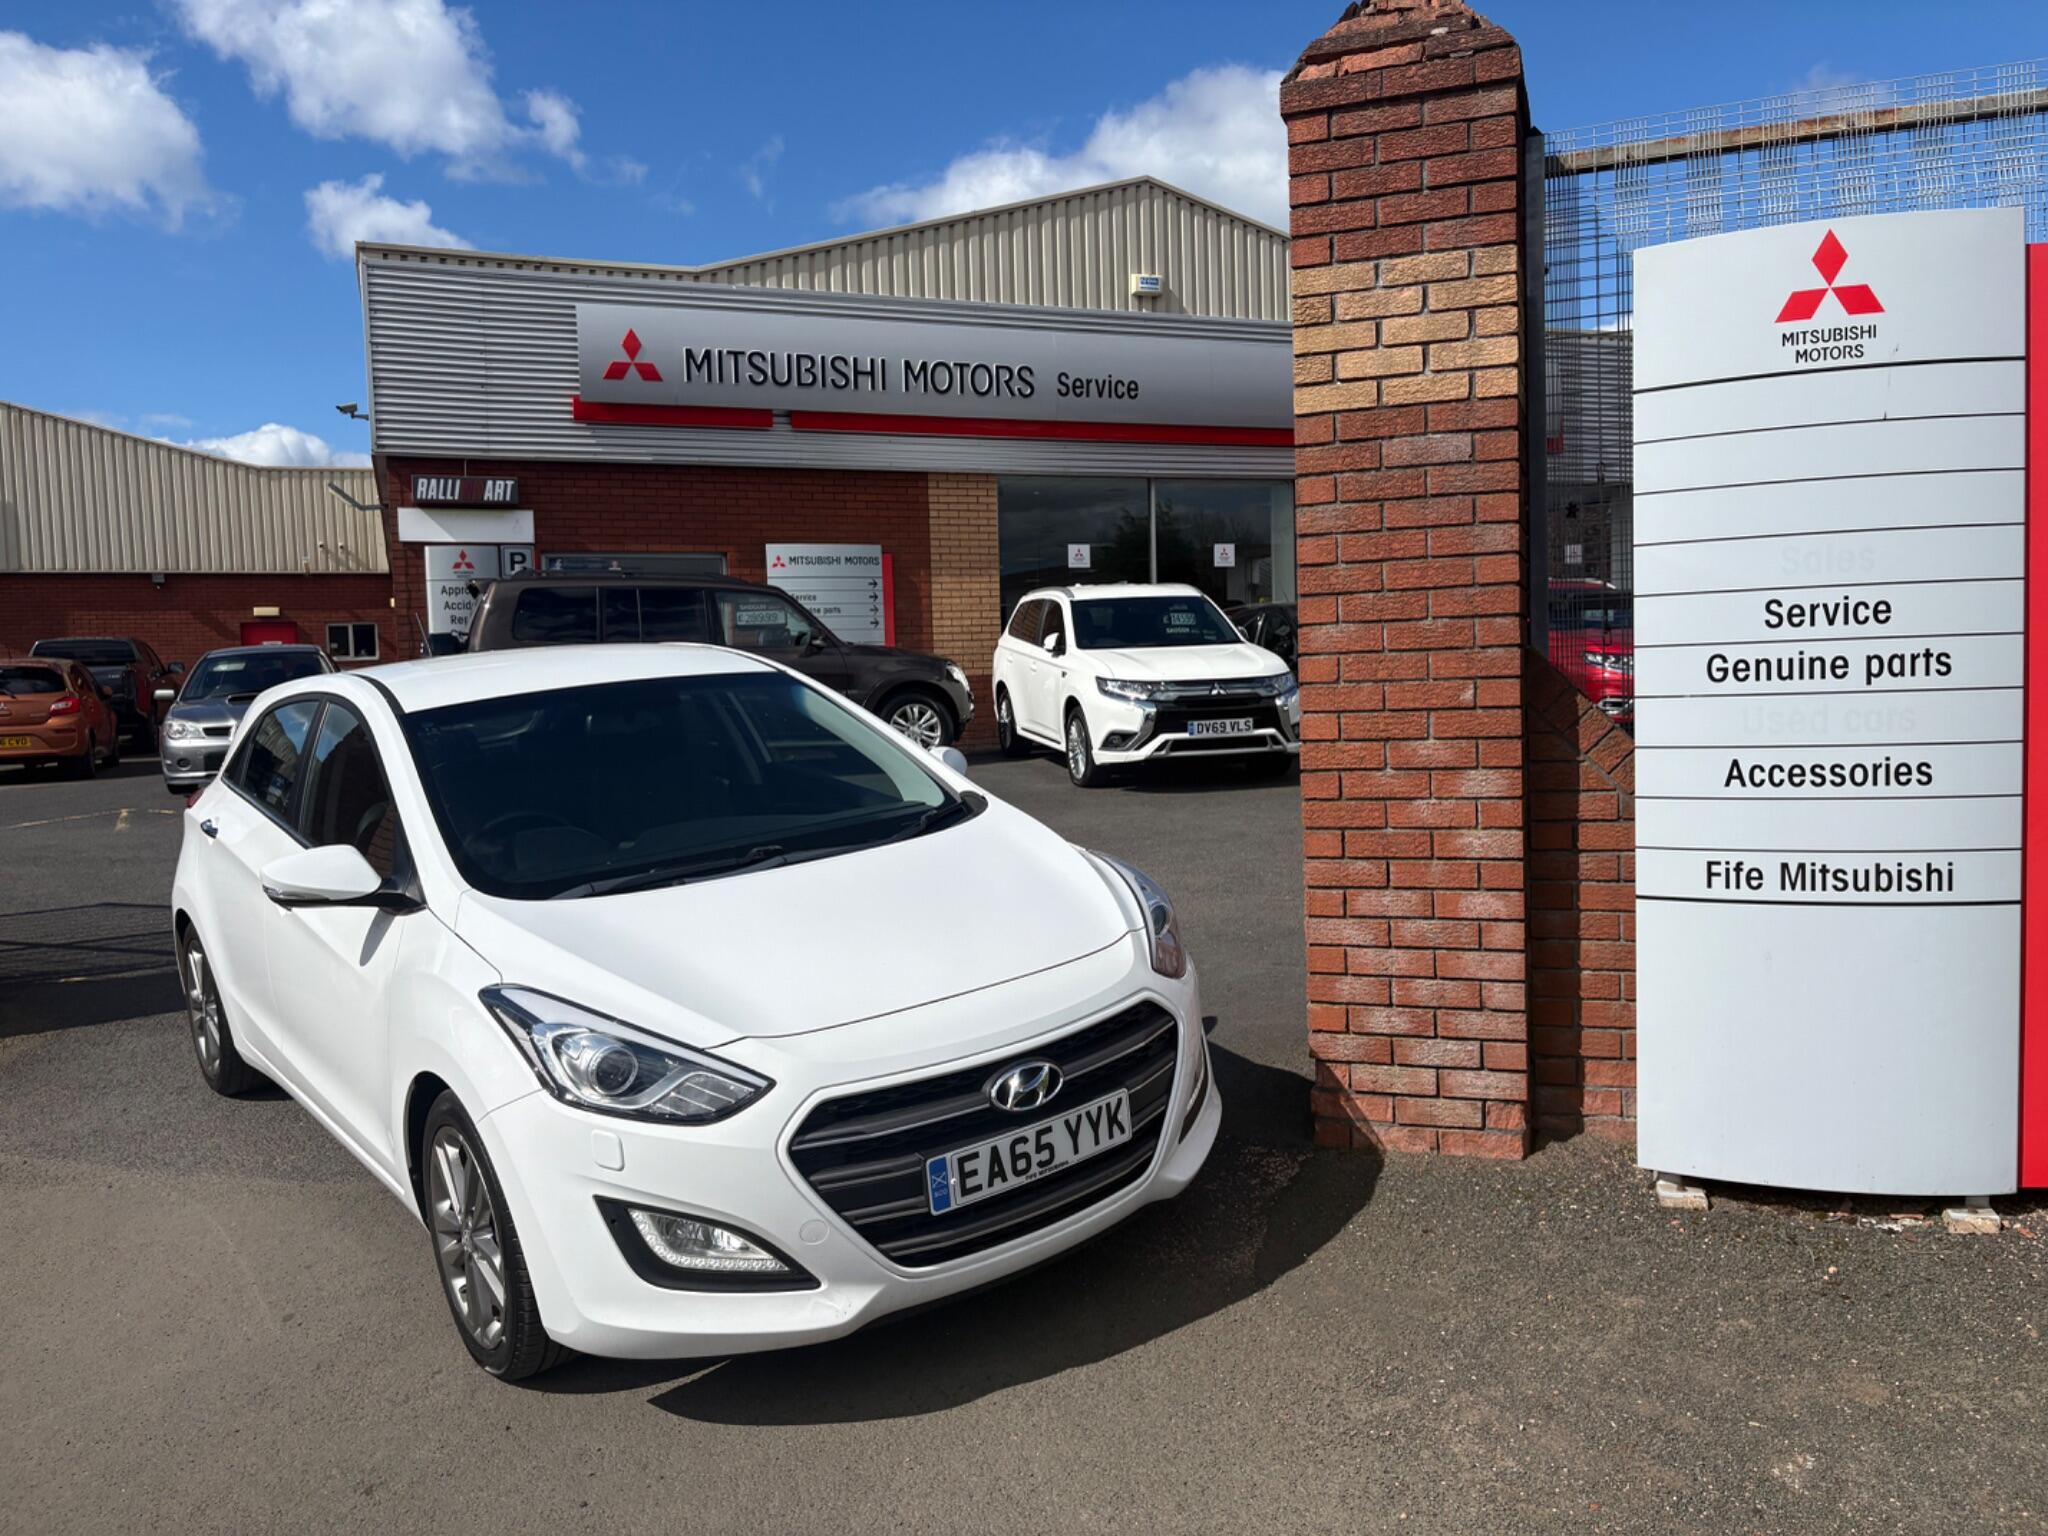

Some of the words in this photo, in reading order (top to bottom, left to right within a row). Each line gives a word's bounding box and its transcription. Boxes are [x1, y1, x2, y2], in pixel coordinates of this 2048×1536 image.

[1782, 324, 1877, 347] MITSUBISHI
[1795, 344, 1864, 363] MOTORS
[683, 347, 887, 392] MITSUBISHI
[902, 360, 1035, 399] MOTORS
[1057, 372, 1139, 400] Service
[416, 478, 460, 500] RALLI
[483, 479, 514, 501] ART
[788, 556, 841, 566] MITSUBISHI
[844, 556, 880, 566] MOTORS
[441, 585, 470, 597] Appro
[444, 600, 472, 611] Accid
[1764, 595, 1893, 629] Service
[1706, 651, 1850, 684] Genuine
[1865, 647, 1953, 685] parts
[1230, 720, 1251, 732] VLS
[1724, 756, 1933, 788] Accessories
[1705, 860, 1764, 891] Fife
[1780, 862, 1955, 893] Mitsubishi
[957, 1127, 1056, 1198] EA65
[1064, 1097, 1126, 1156] YYK
